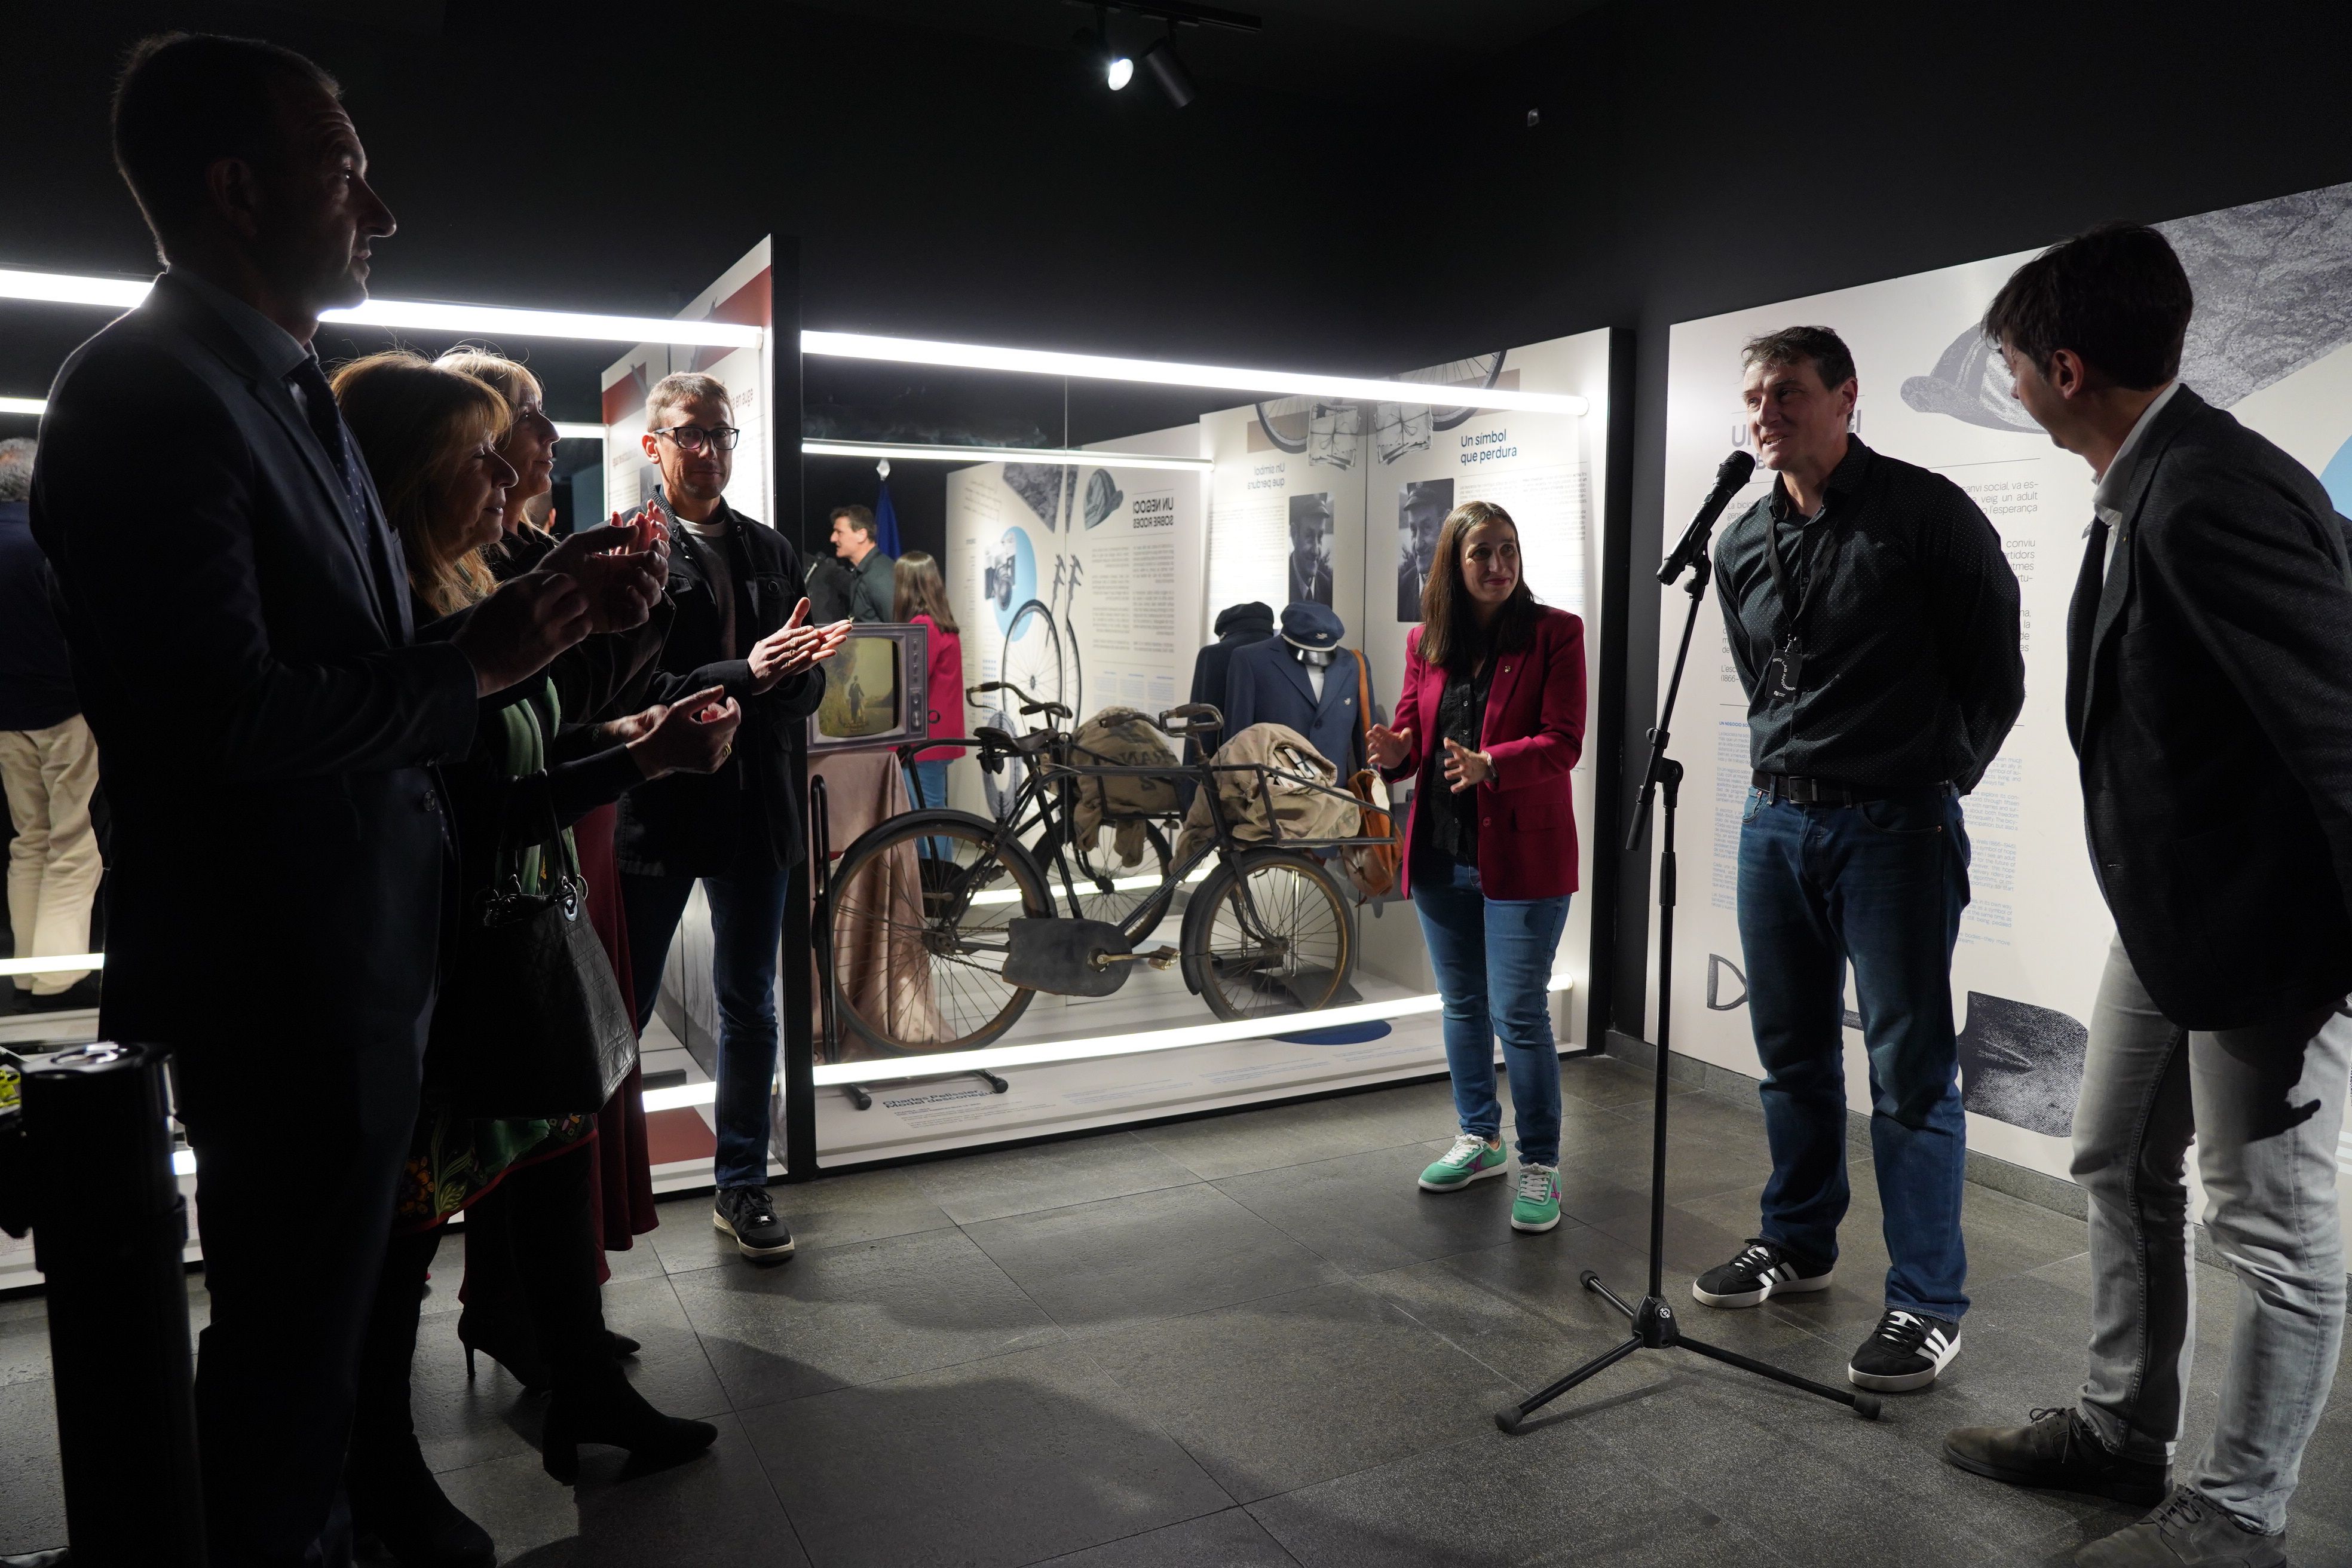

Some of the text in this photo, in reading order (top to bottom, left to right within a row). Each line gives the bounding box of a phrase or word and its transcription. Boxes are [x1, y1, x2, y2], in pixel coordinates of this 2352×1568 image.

[1460, 428, 1506, 447] Un símbol
[1460, 446, 1517, 466] que perdura
[1984, 482, 2010, 492] social,
[1981, 495, 1998, 505] veig
[2002, 494, 2013, 502] un
[2017, 491, 2038, 501] adult
[1990, 504, 2038, 515] l'esperança
[2006, 538, 2036, 548] conviu
[2023, 619, 2031, 629] la
[1781, 672, 1796, 691] ANDORRA
[883, 1097, 928, 1105] Charles
[886, 1100, 925, 1108] Model
